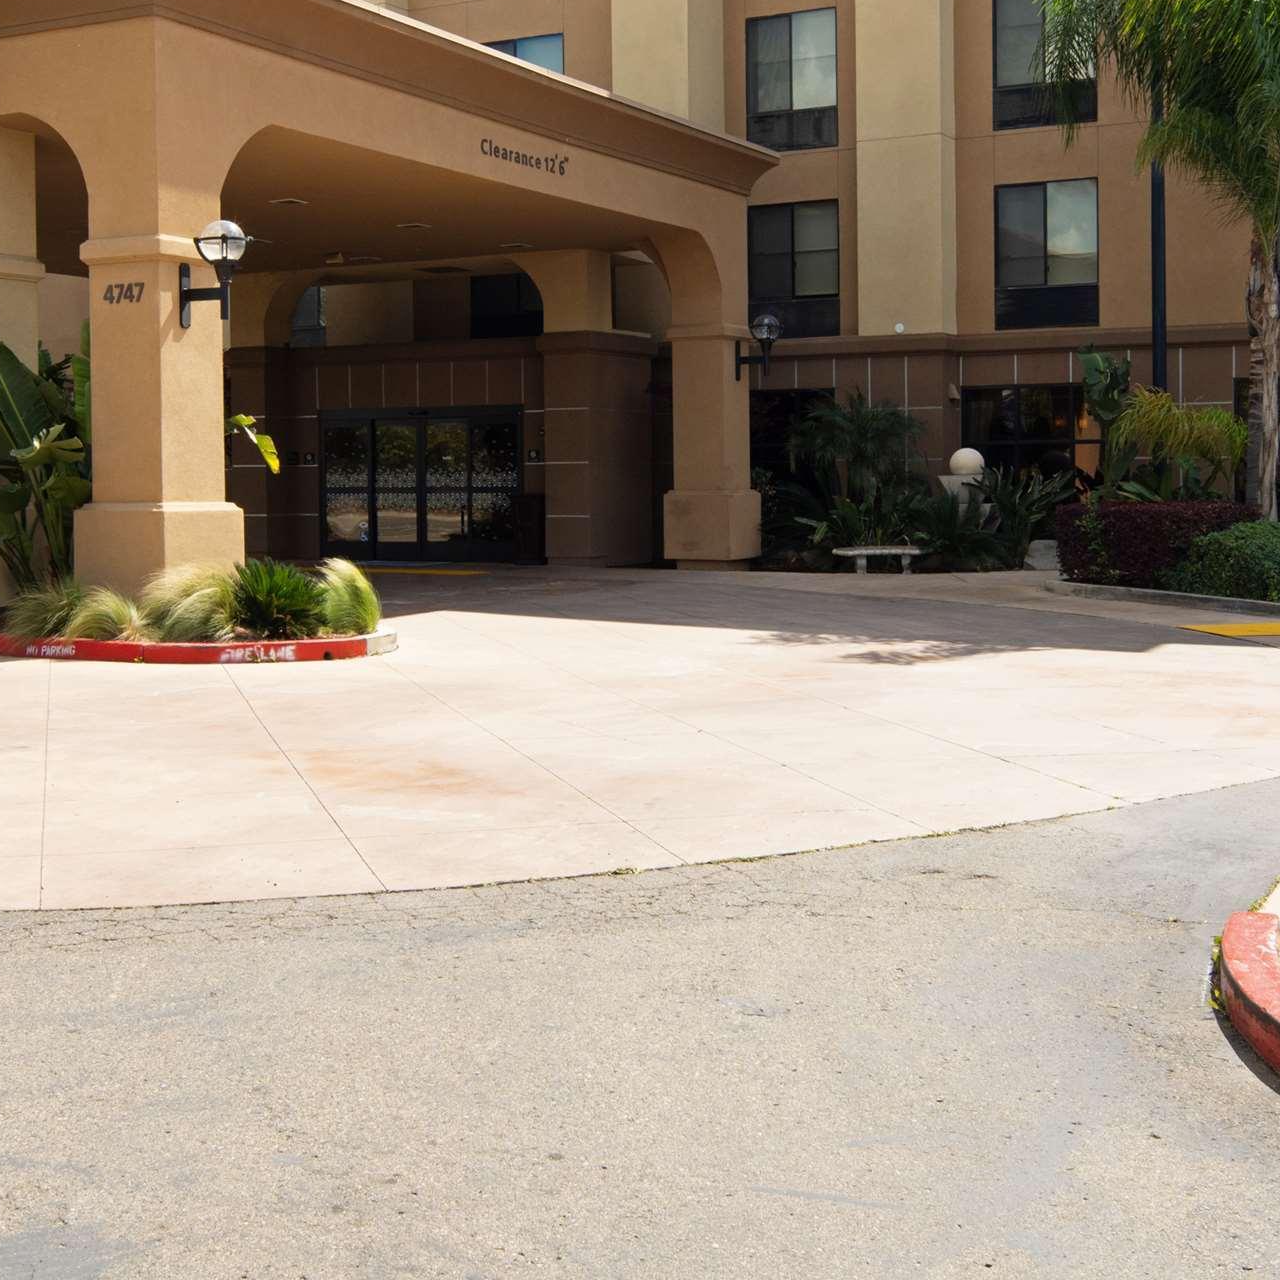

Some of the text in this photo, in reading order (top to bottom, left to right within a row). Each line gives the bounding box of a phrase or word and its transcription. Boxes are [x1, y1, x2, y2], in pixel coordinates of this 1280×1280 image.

[480, 138, 542, 170] Clearance
[103, 282, 145, 305] 4747
[26, 644, 76, 656] NO PARKING
